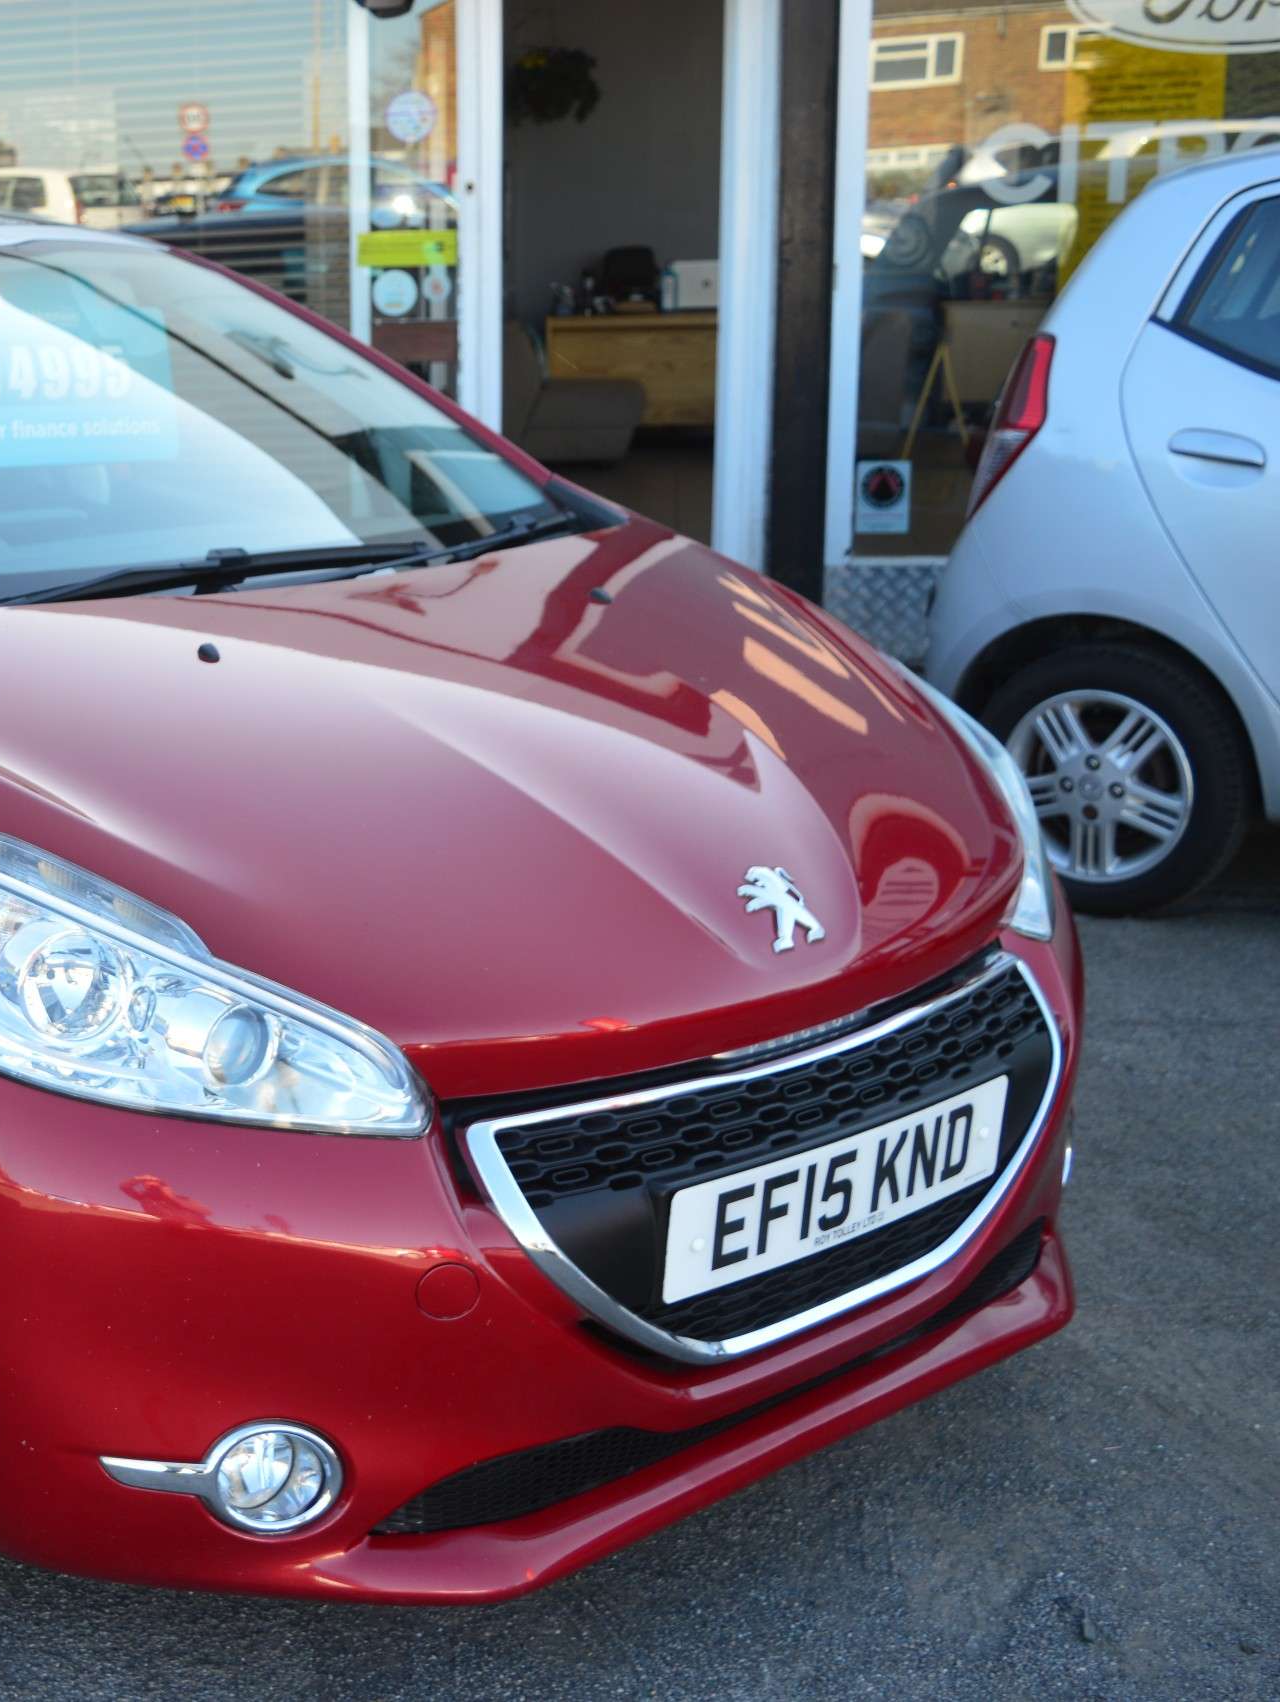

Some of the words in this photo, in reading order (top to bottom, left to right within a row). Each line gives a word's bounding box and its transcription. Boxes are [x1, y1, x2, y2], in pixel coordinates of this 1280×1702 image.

[11, 418, 78, 439] finance
[82, 416, 161, 438] solutions
[711, 1149, 858, 1271] EF15
[870, 1103, 974, 1212] KND
